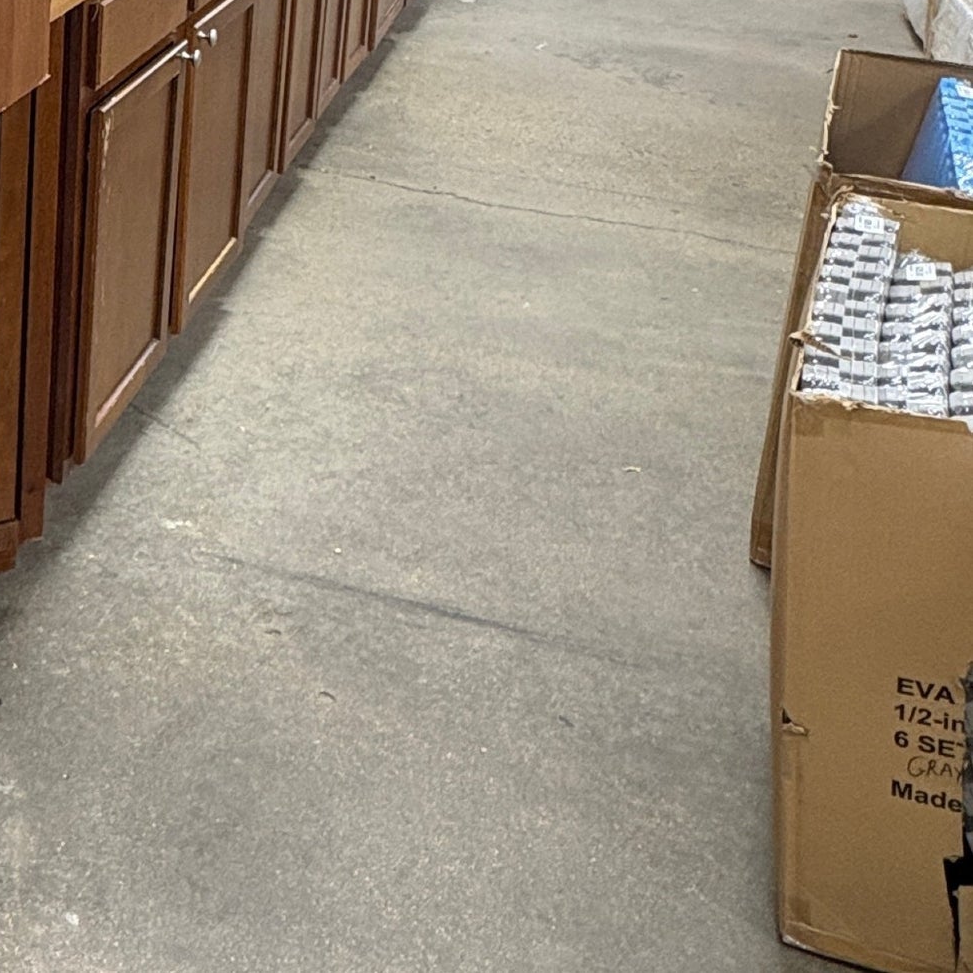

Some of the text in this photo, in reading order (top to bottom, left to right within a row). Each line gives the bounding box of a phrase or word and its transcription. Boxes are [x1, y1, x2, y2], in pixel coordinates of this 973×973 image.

[896, 677, 955, 704] EVA
[894, 704, 965, 734] 1/2-in
[894, 731, 909, 748] 6
[891, 779, 963, 813] Made
